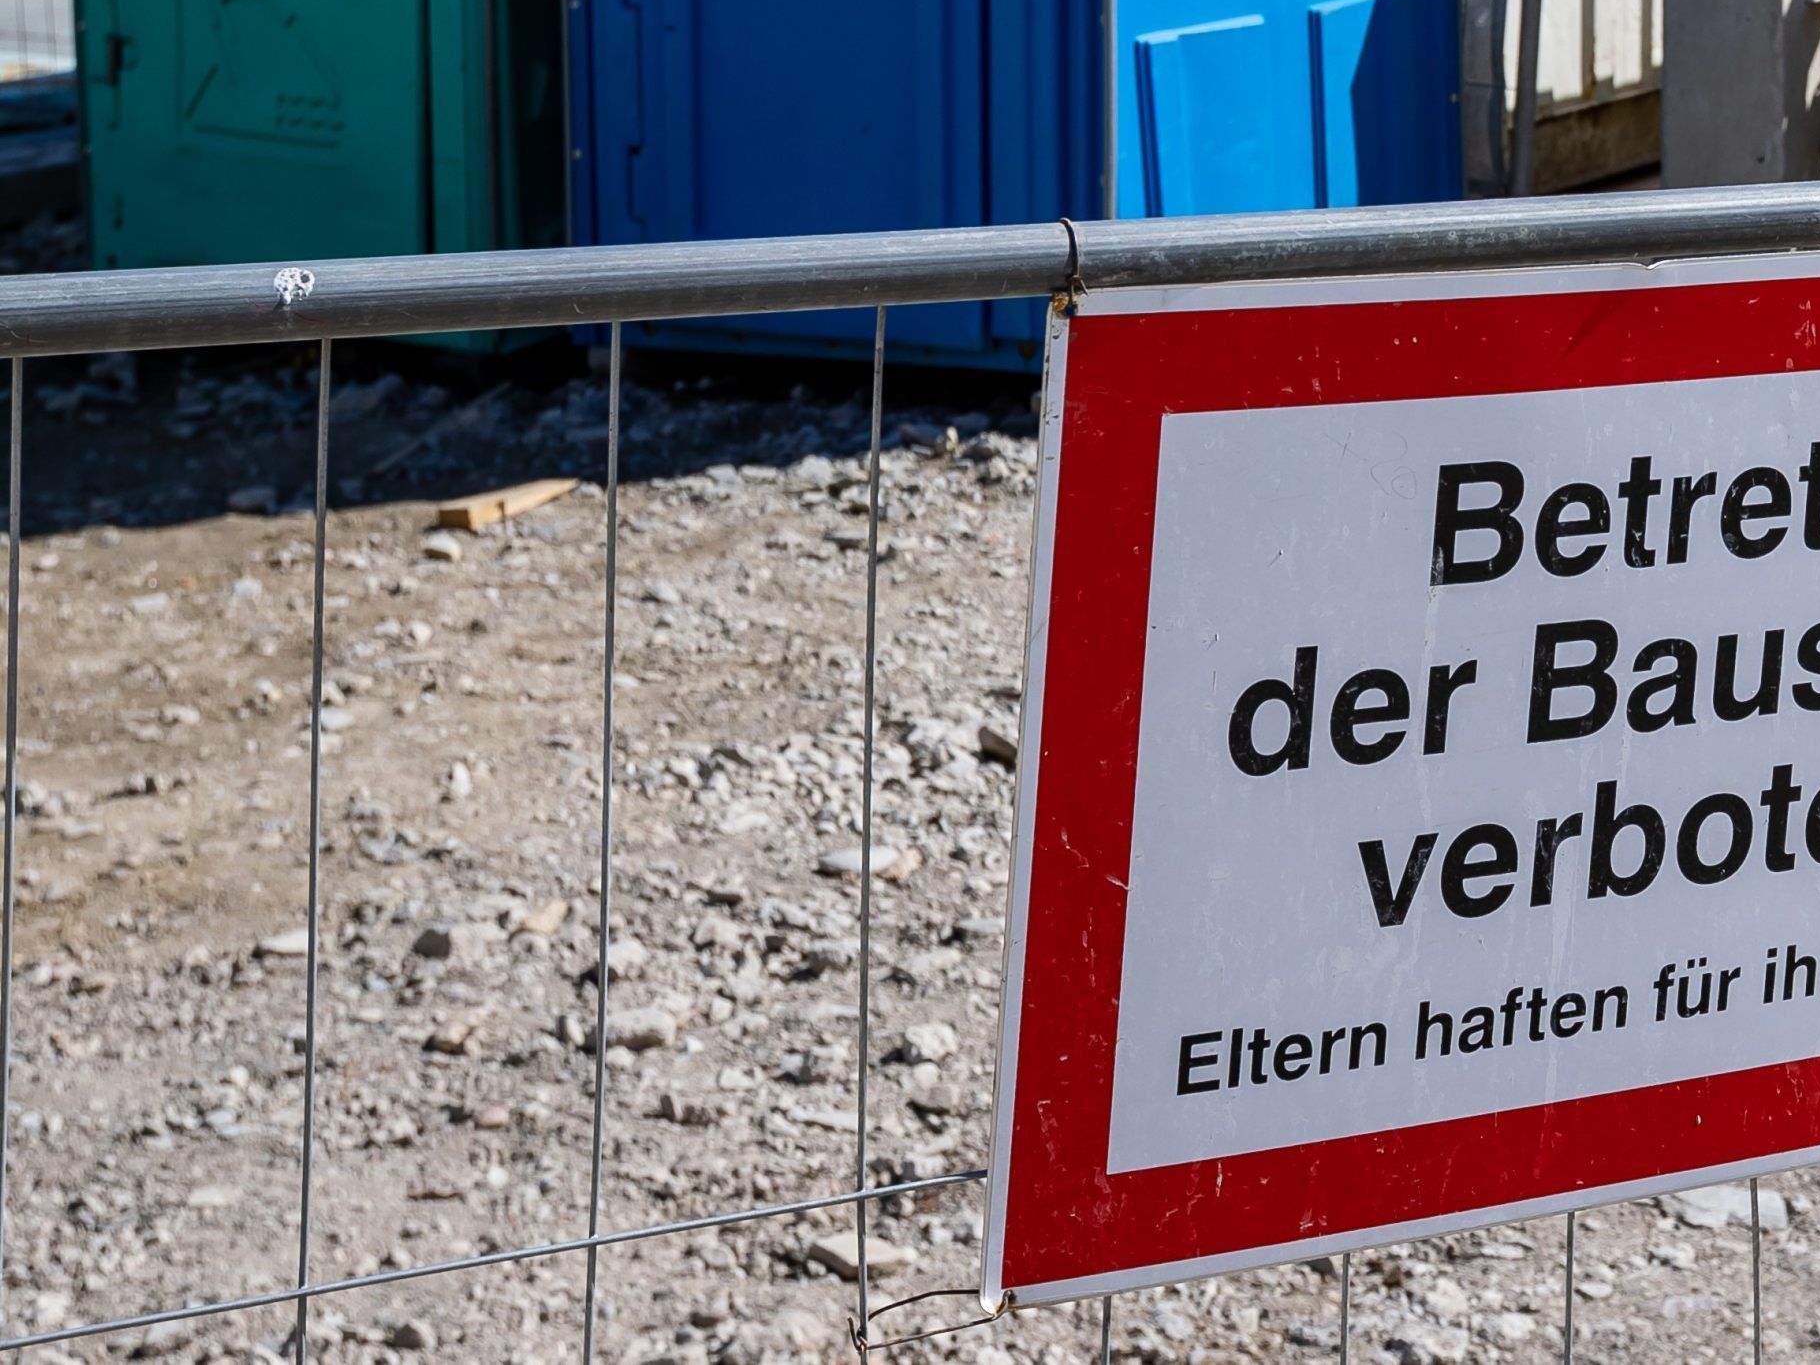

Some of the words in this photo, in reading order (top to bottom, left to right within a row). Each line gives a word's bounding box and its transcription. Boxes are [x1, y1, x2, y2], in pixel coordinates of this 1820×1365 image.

[1228, 647, 1477, 776] der
[1176, 1021, 1387, 1095] Eltern
[1415, 983, 1629, 1060] haften
[1653, 959, 1740, 1023] für
